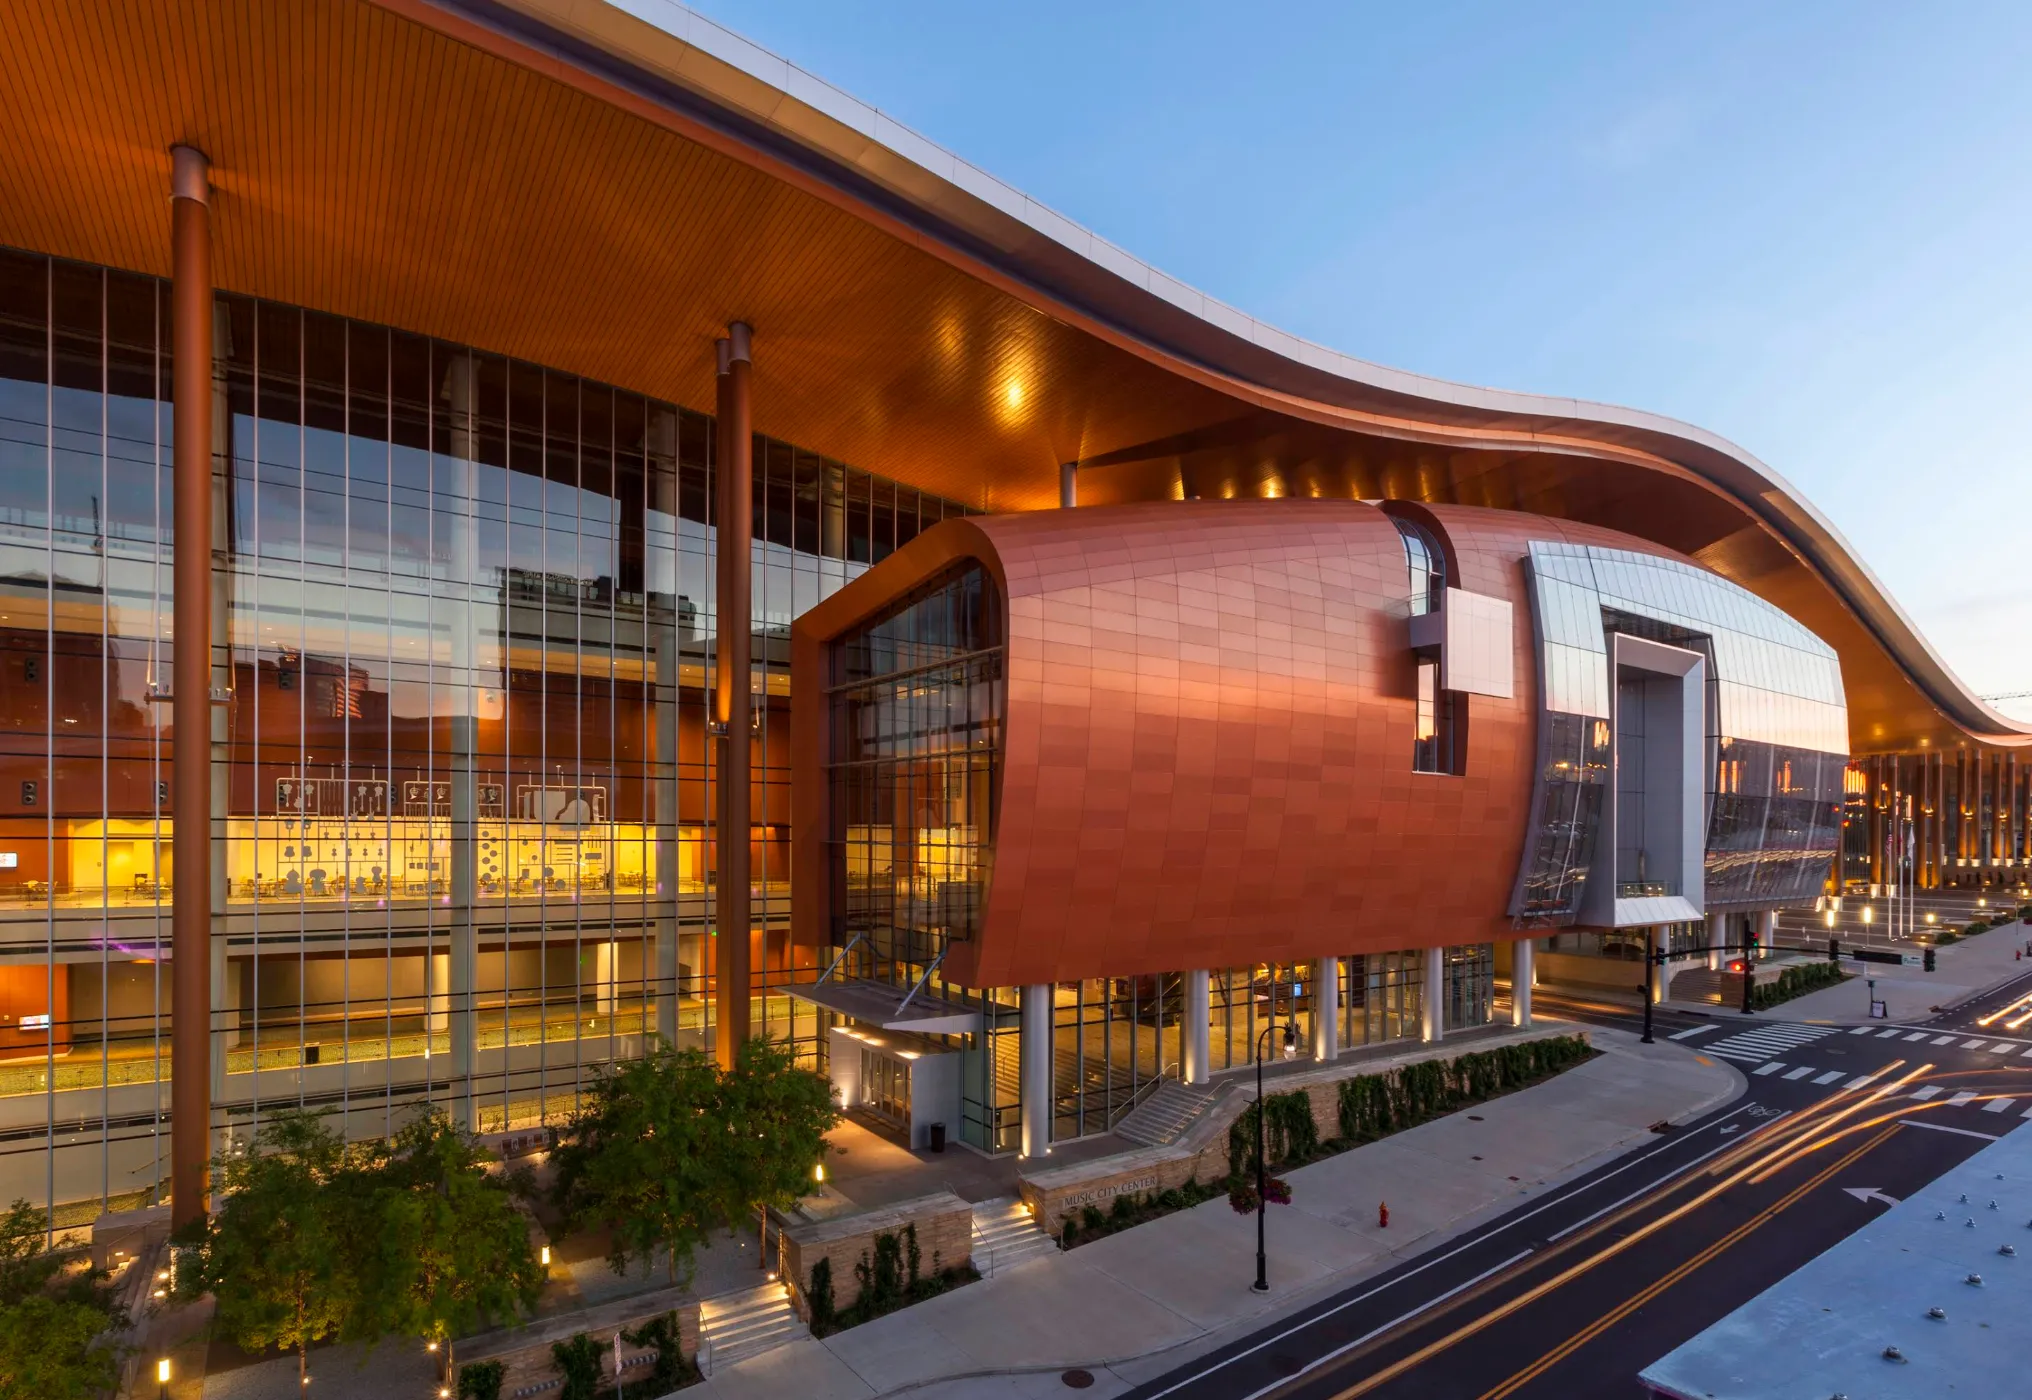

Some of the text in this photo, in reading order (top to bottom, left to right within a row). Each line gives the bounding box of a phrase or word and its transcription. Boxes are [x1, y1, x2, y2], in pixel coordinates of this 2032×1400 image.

[1064, 1176, 1156, 1206] MUSIC CITY CENTER
